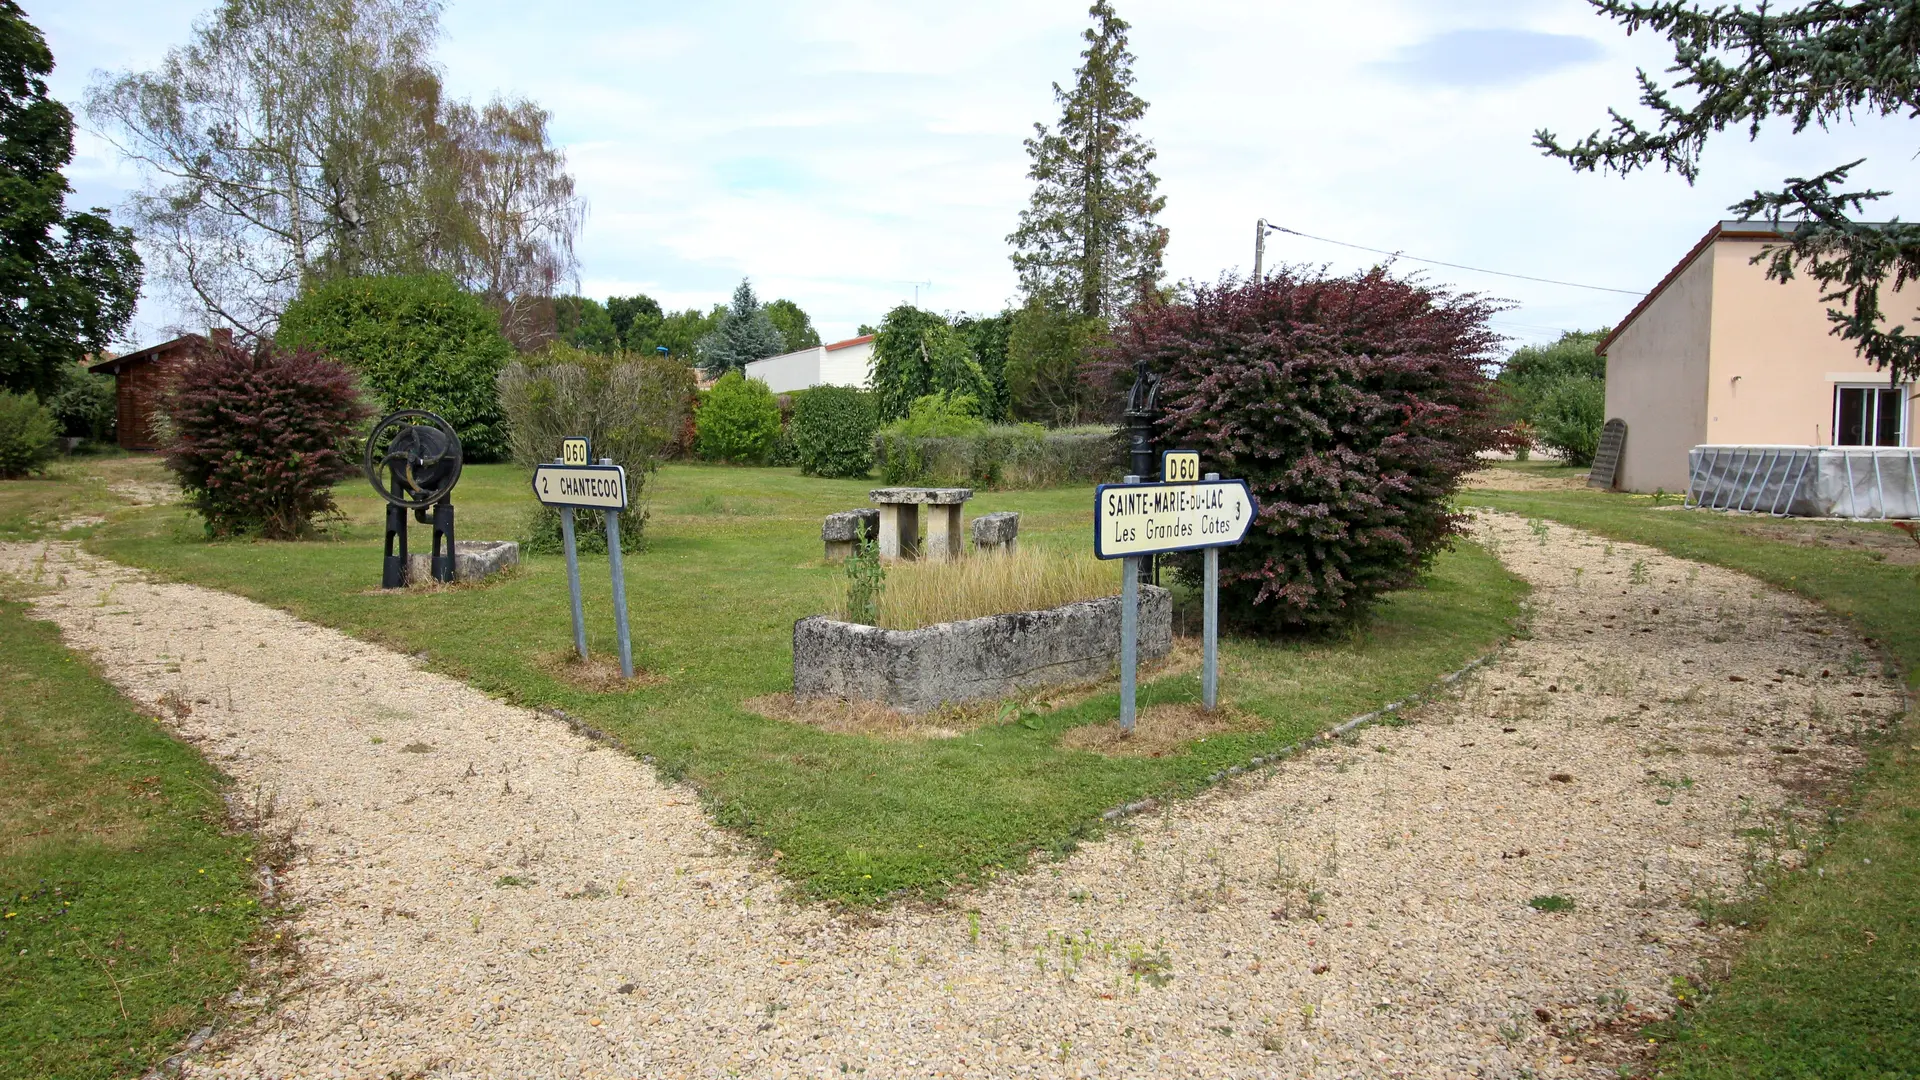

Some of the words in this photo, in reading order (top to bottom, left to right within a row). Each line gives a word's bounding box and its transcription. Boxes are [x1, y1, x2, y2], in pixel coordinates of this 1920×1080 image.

[566, 444, 585, 462] D60
[542, 476, 549, 494] 2
[560, 477, 618, 499] CHANTECOQ
[1108, 489, 1224, 516] SAINTE-MARIE-DU-LAC
[1235, 501, 1241, 521] 3
[1115, 521, 1136, 543] Les
[1146, 517, 1193, 540] Grandes
[1201, 514, 1230, 535] Côtes
